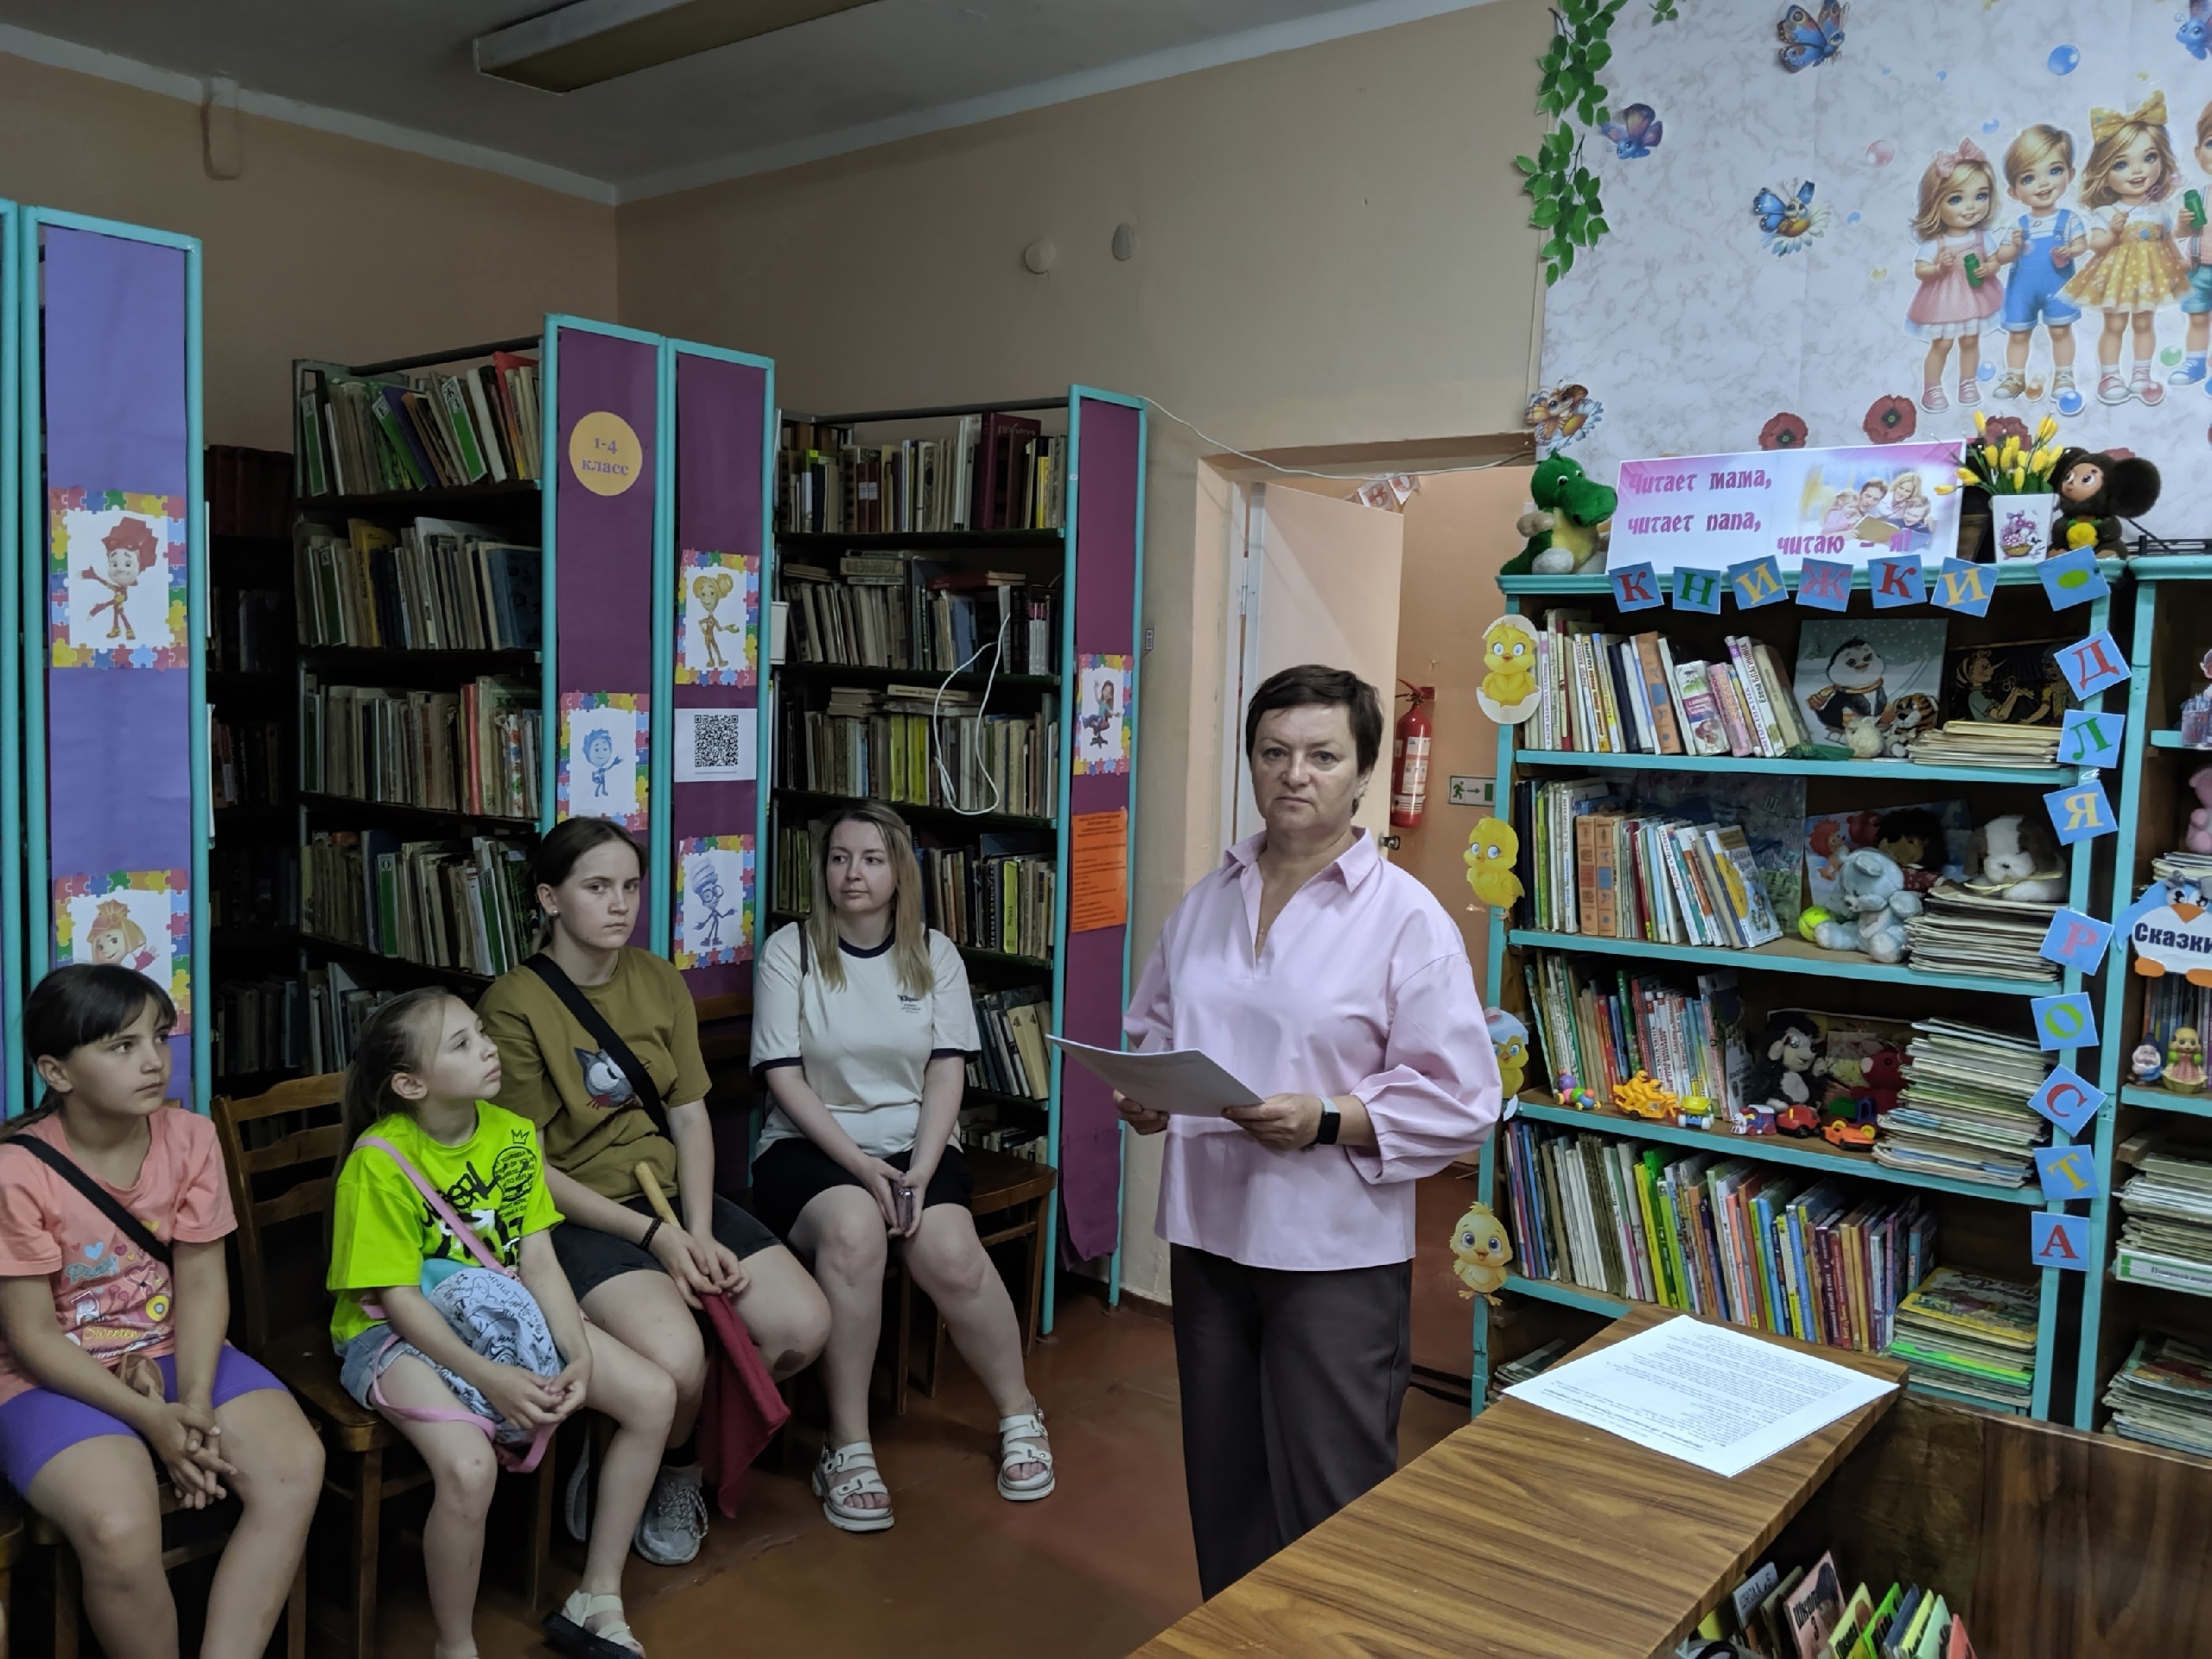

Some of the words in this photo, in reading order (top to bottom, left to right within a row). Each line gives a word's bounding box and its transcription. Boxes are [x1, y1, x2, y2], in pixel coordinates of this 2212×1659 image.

[594, 437, 618, 454] 1-4
[582, 459, 629, 476] класс
[1629, 473, 1698, 495] Читает
[1708, 469, 1772, 490] мама,
[1627, 514, 1695, 535] читает
[1706, 512, 1762, 532] папа,
[1777, 535, 1845, 555] читаю
[1013, 1016, 1022, 1027] 4
[1029, 1013, 1036, 1024] 4
